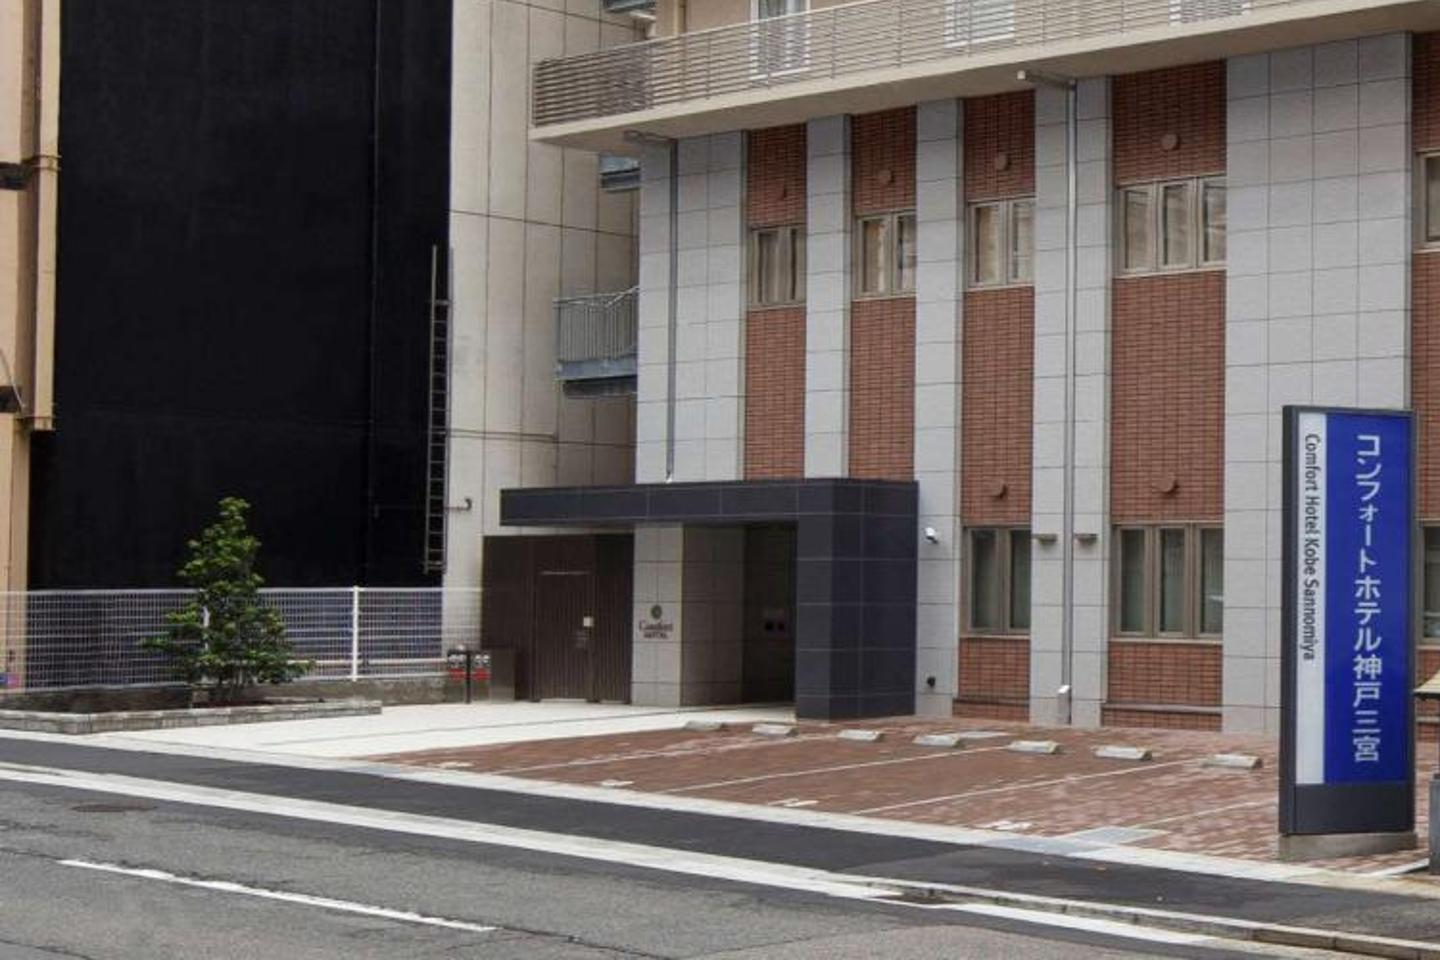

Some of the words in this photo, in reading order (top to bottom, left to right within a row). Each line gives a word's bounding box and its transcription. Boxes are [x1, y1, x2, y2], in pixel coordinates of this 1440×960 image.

[1304, 433, 1321, 492] Comfort
[1304, 496, 1320, 535] Hotel
[1303, 538, 1320, 575] Kobe
[1300, 579, 1320, 662] Sannomiya
[1352, 434, 1383, 763] コンフォートホテル神戸三宮
